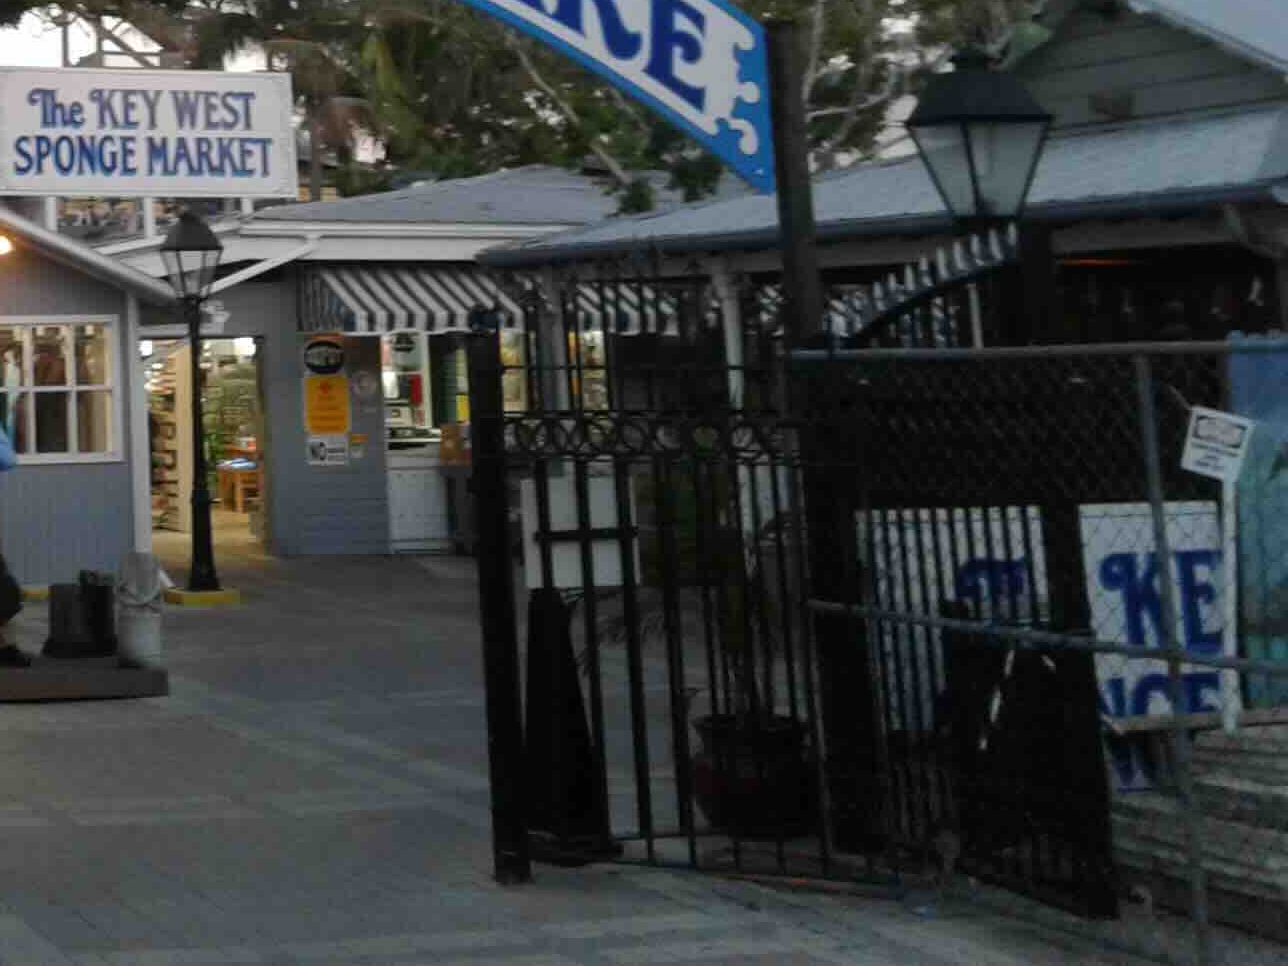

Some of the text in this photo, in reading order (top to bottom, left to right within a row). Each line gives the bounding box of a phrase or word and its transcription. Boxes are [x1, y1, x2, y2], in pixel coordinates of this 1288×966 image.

[27, 88, 256, 131] The KEY WEST
[14, 136, 274, 178] SPONGE MARKET
